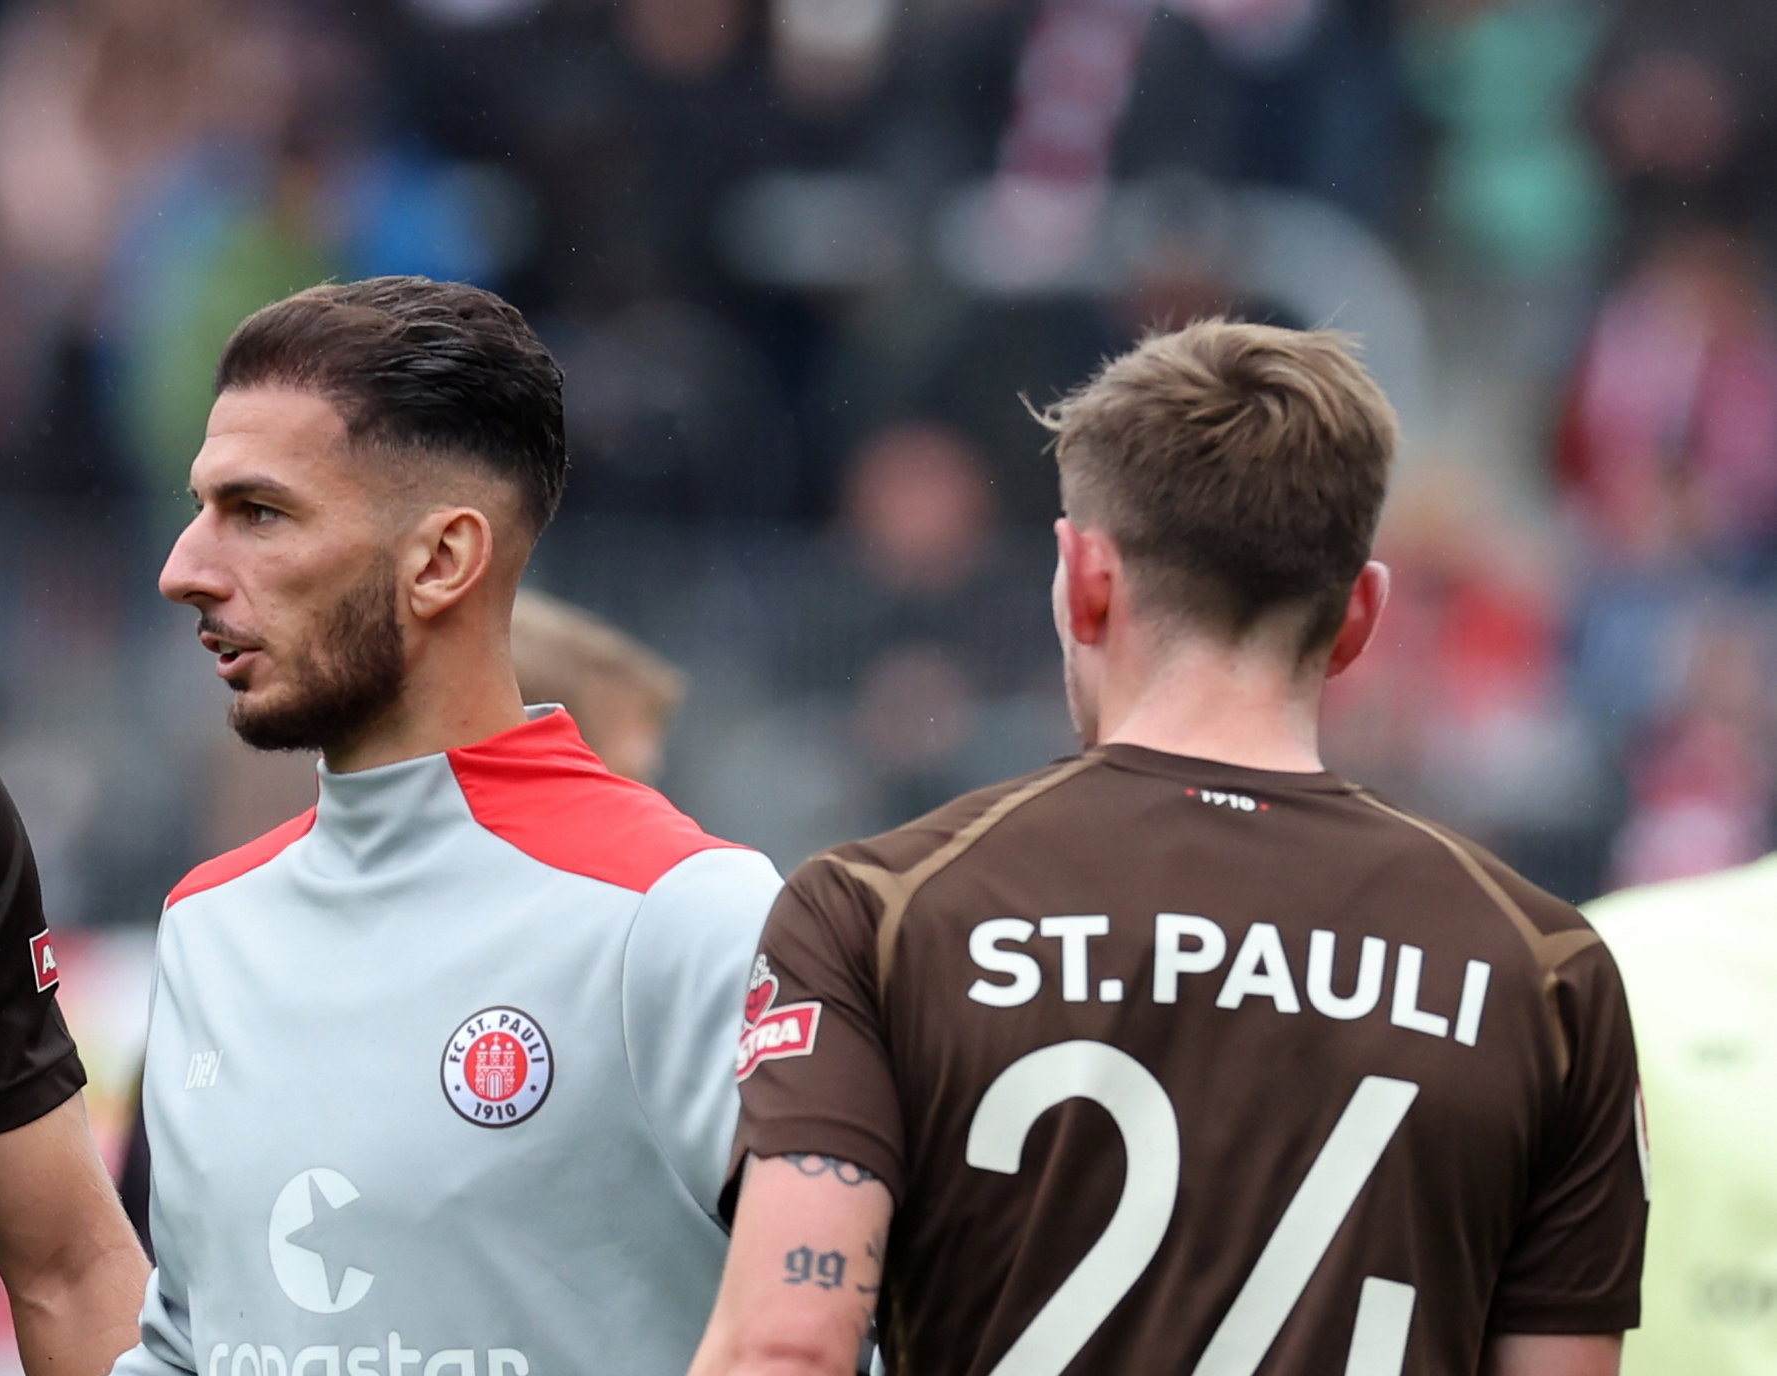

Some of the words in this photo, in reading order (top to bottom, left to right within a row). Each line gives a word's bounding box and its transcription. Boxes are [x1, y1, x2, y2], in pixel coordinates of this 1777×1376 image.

[1200, 789, 1257, 813] 1910
[967, 913, 1124, 1007] ST.
[1153, 913, 1491, 1047] PAULI
[448, 1041, 466, 1064] FC
[466, 1018, 492, 1039] ST.
[499, 1013, 545, 1064] PAULI
[736, 1016, 802, 1072] STRA
[474, 1101, 518, 1121] 1910
